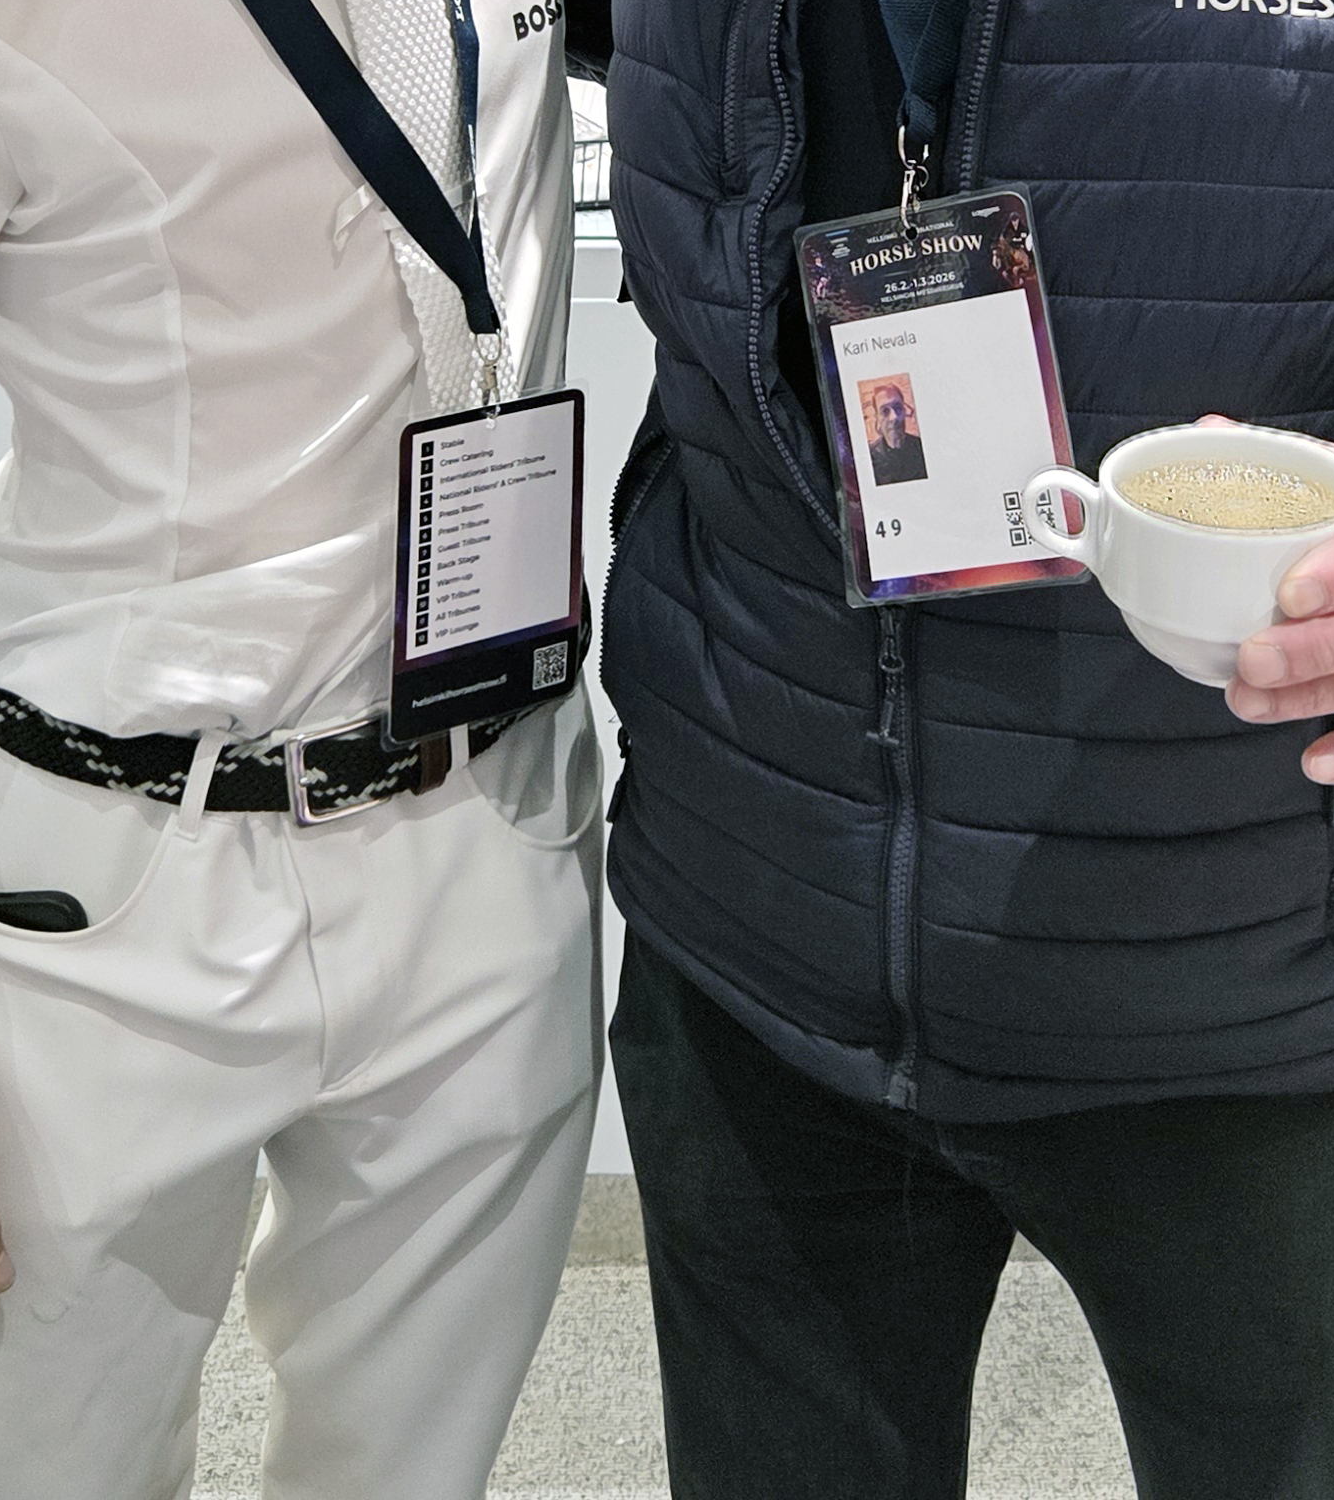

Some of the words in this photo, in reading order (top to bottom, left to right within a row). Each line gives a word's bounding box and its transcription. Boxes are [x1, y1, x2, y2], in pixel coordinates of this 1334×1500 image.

[849, 242, 917, 277] HORSE
[921, 234, 983, 257] SHOW
[842, 338, 869, 357] Kari
[871, 330, 917, 351] Nevala
[440, 439, 465, 450] Stable
